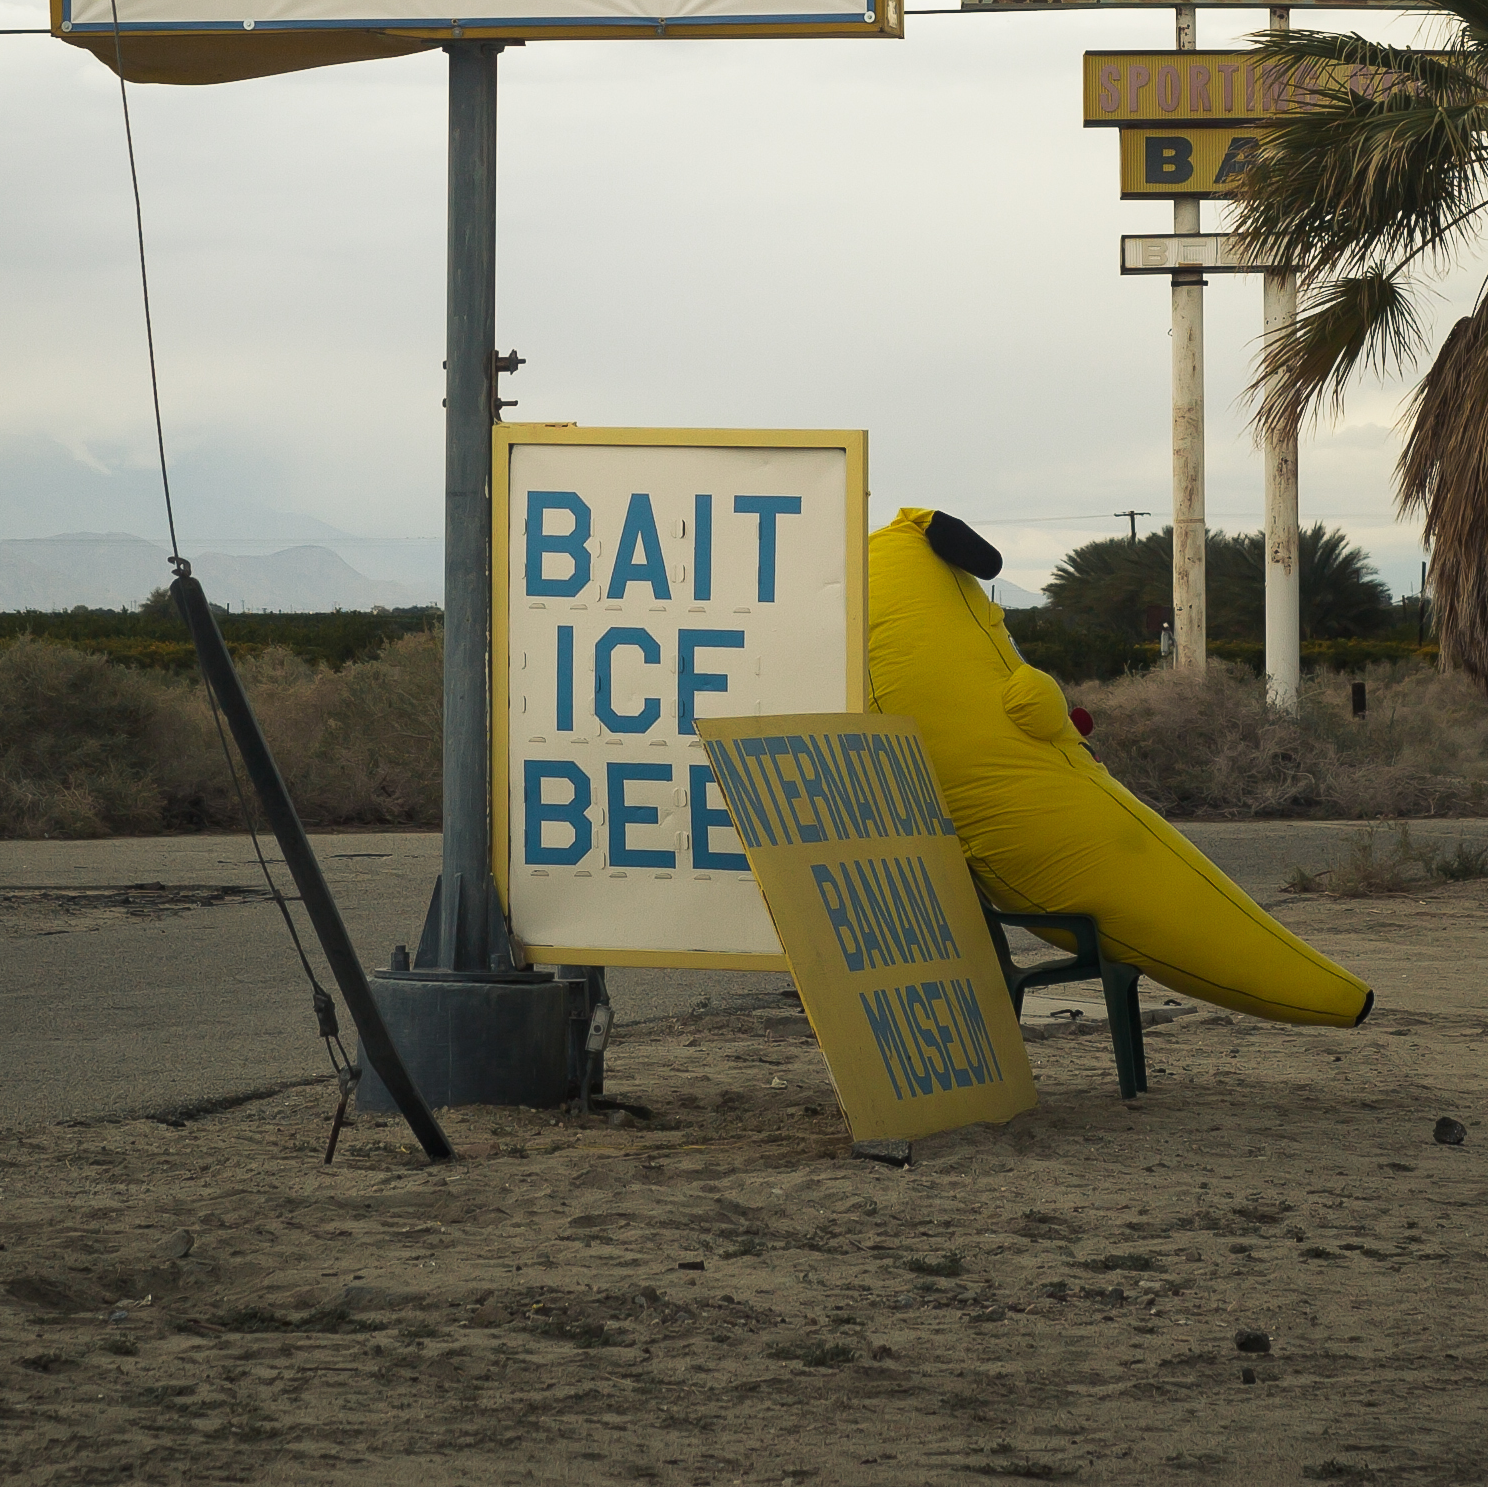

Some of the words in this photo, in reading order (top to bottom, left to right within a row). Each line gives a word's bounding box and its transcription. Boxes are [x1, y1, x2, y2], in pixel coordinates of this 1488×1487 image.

[524, 490, 803, 603] BAIT
[556, 625, 745, 735] ICE
[706, 732, 957, 848] INTERNATIONAL
[810, 856, 962, 973] BANANA
[858, 977, 1004, 1101] MUSEUM
